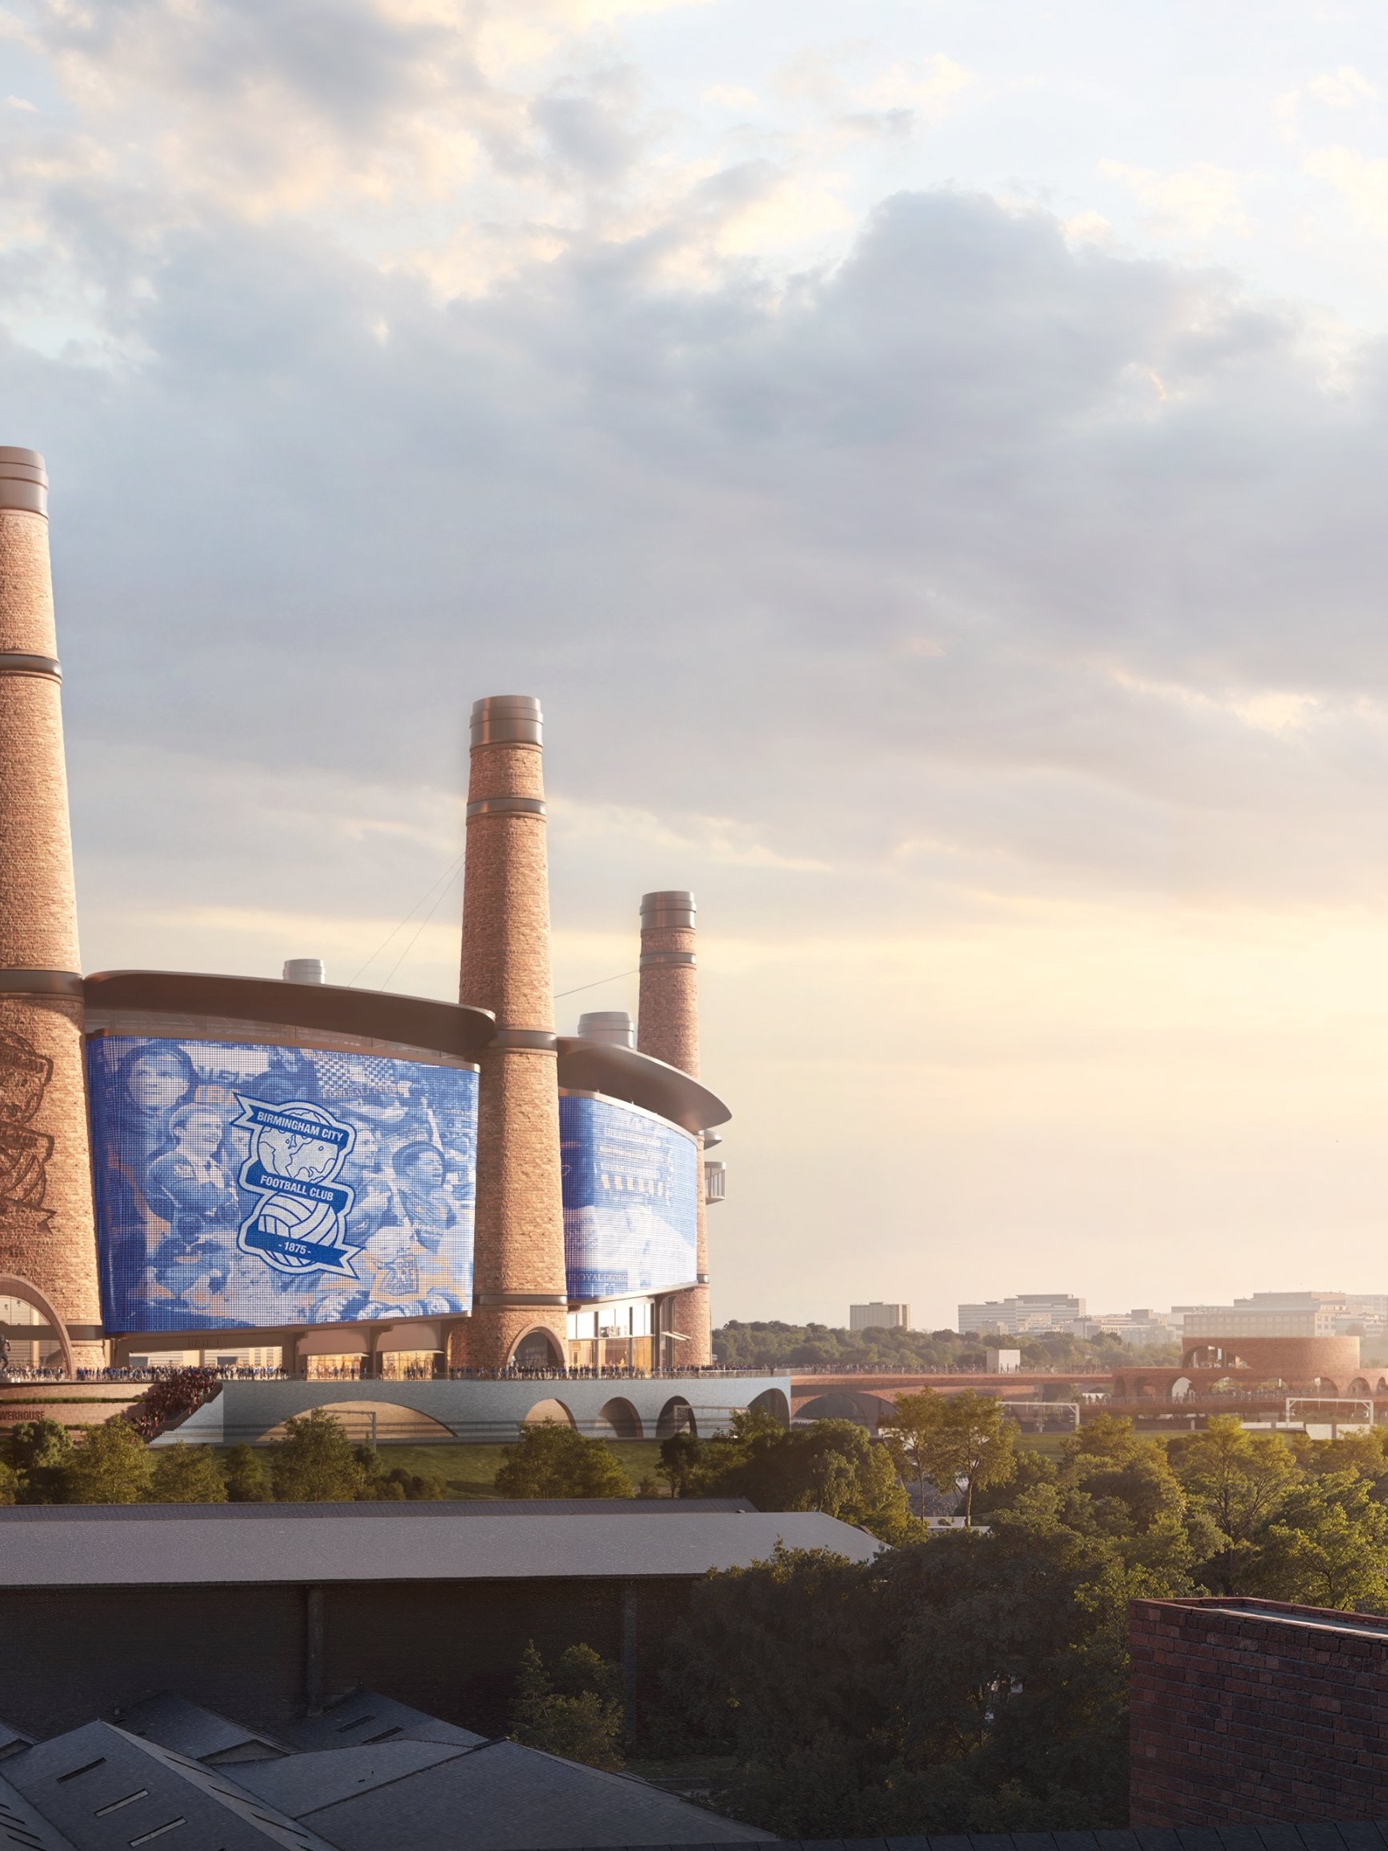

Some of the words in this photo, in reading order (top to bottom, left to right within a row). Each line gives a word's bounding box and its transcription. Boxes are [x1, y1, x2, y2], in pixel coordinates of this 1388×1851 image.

[257, 1112, 319, 1136] BIRMINGHAM
[321, 1128, 344, 1142] CITY
[260, 1175, 307, 1196] FOOTBALL
[309, 1187, 334, 1201] CLUB
